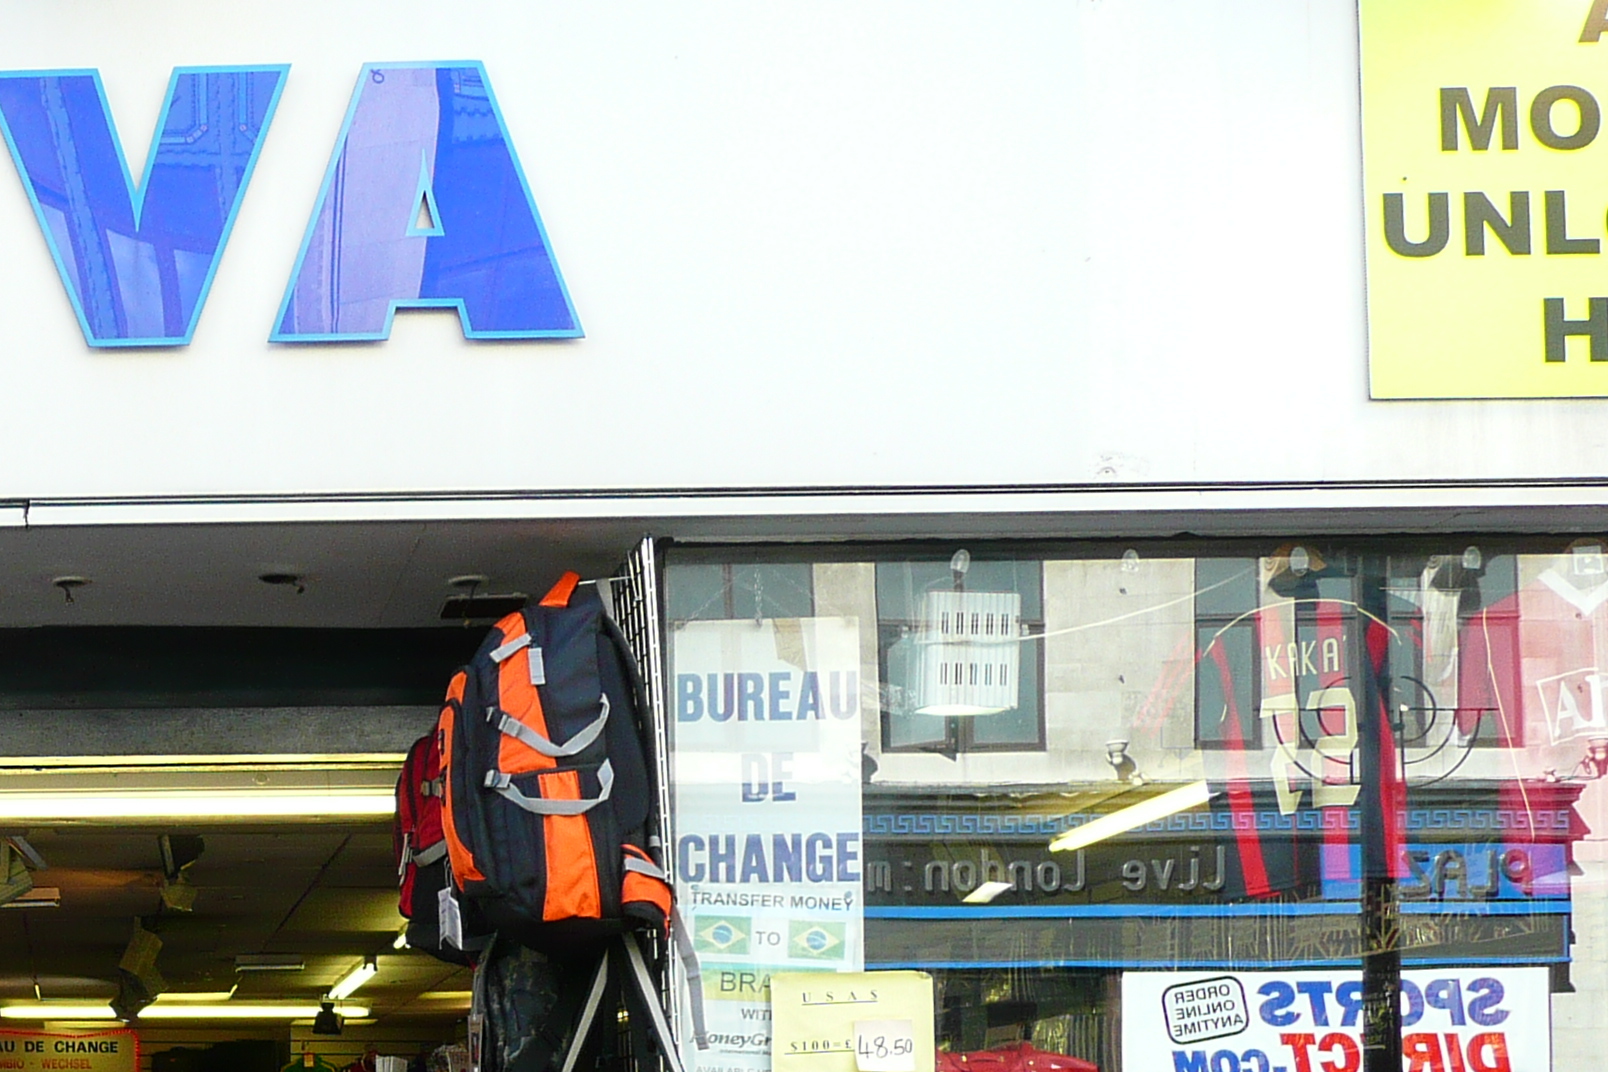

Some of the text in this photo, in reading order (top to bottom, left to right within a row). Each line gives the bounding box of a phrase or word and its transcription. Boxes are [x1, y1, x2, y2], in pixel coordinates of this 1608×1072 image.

[676, 670, 858, 723] BUREAU
[740, 752, 797, 803] DE
[677, 832, 861, 884] CHANGE
[691, 890, 853, 912] TRANSFER MONEY
[756, 930, 781, 947] TO
[24, 1040, 45, 1053] DE
[53, 1040, 119, 1054] CHANGE
[857, 1034, 913, 1059] 48.50
[41, 1058, 92, 1070] WECHSEL
